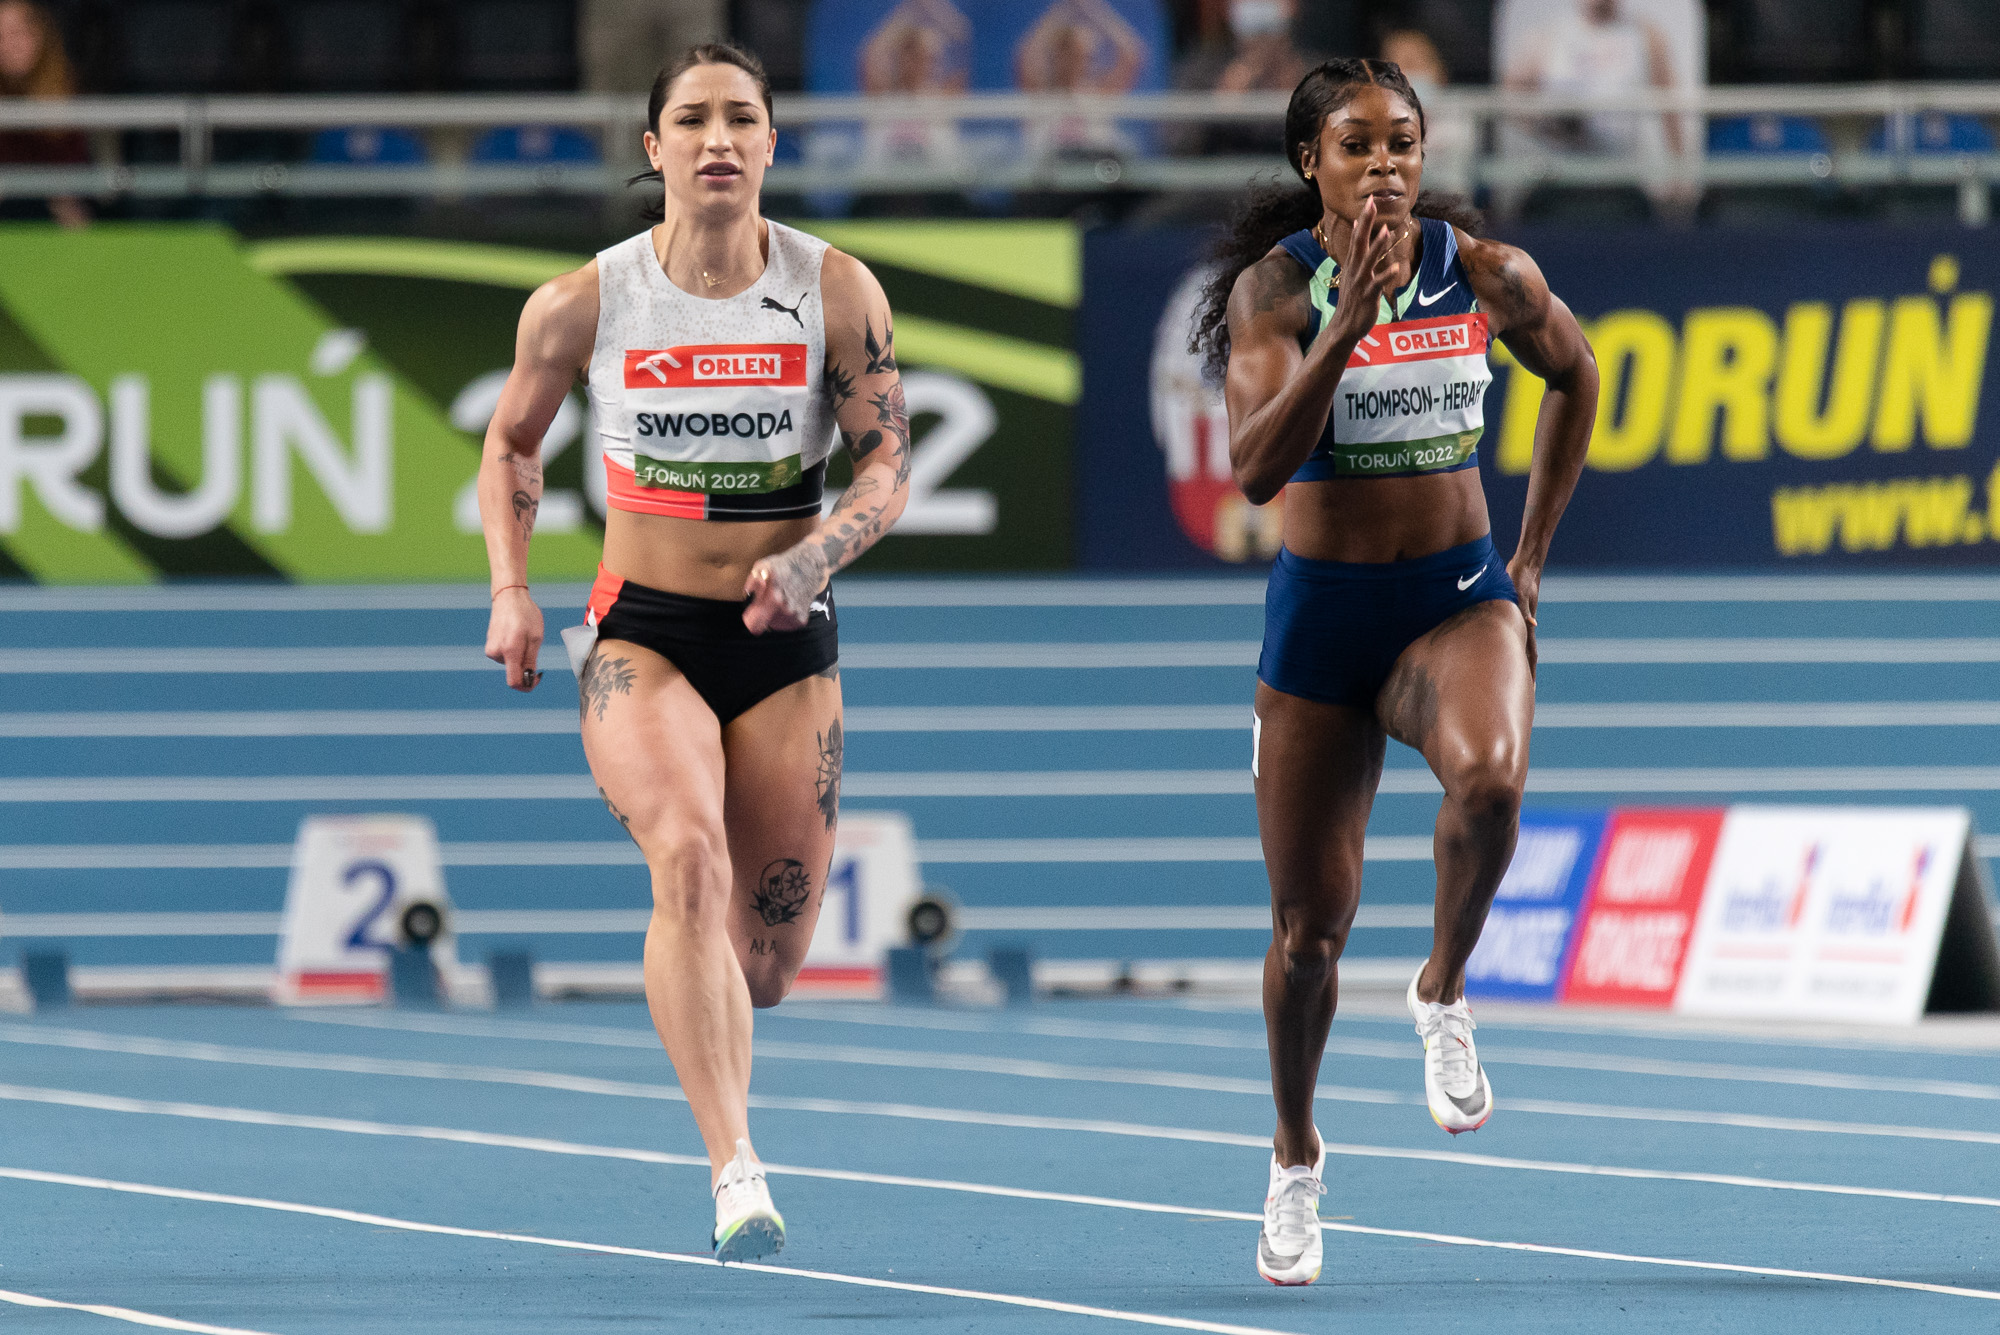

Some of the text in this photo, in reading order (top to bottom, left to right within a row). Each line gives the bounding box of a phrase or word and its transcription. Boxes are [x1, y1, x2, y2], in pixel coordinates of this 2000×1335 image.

[1394, 327, 1466, 352] ORLEN
[697, 357, 776, 377] ORLEN
[635, 408, 794, 440] SWOBODA
[1346, 445, 1455, 470] TORUŃ 2022
[644, 466, 761, 489] TORUŃ 2022
[1771, 458, 2000, 558] www.
[341, 858, 398, 953] 2
[828, 856, 863, 946] 1
